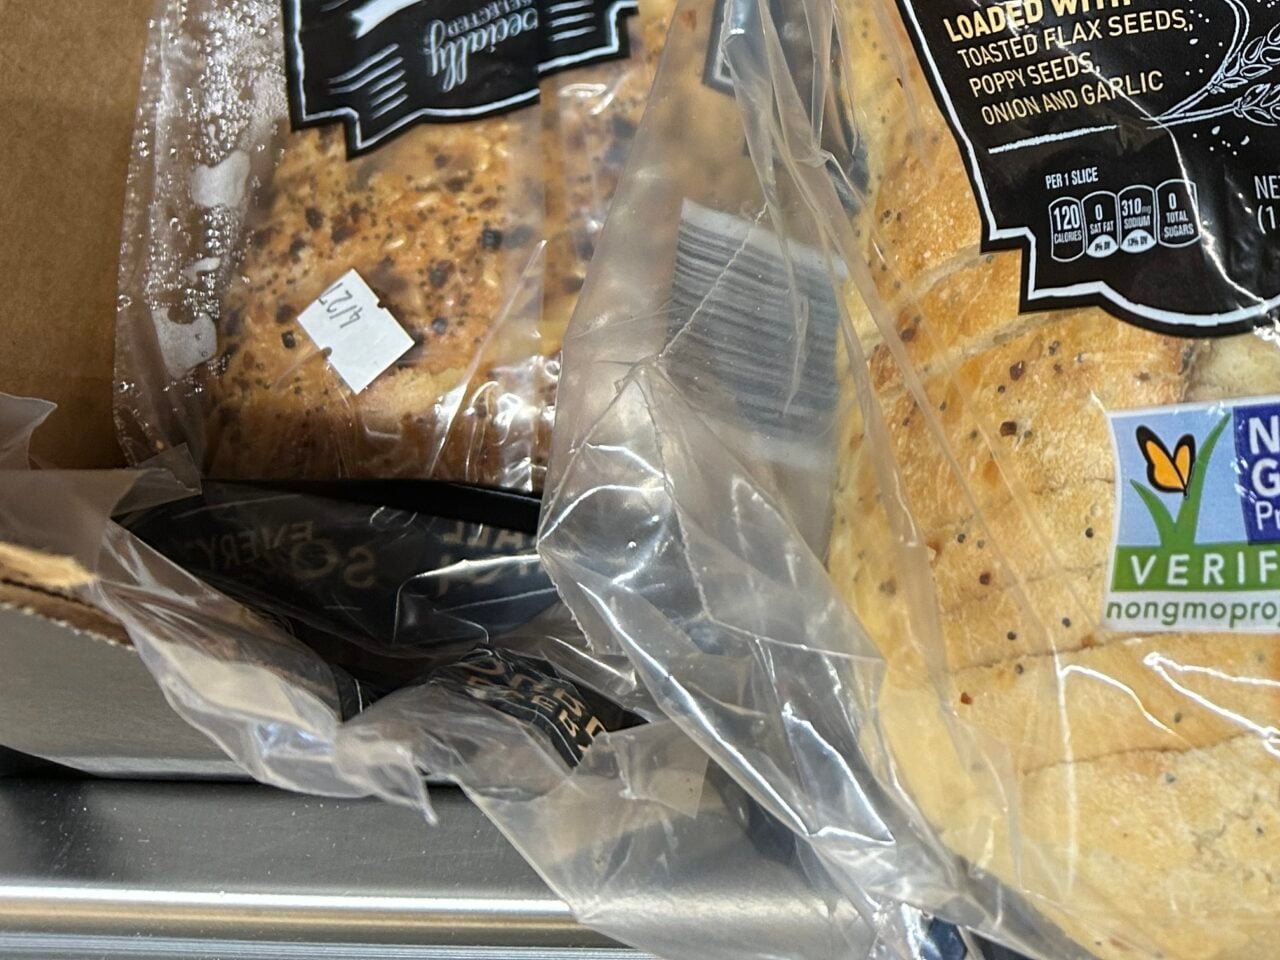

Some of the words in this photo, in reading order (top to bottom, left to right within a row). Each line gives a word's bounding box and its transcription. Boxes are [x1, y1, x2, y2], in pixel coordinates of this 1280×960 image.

[957, 34, 1039, 69] TOASTED
[1044, 19, 1102, 51] FLAX
[968, 68, 1027, 98] POPPY
[1027, 52, 1101, 86] SEEDS,
[981, 94, 1040, 126] ONION
[1042, 85, 1078, 113] AND
[1081, 69, 1165, 104] GARLIC
[1045, 174, 1063, 189] PER
[1064, 174, 1068, 186] 1
[1072, 166, 1099, 185] SLICE
[1168, 193, 1176, 209] 0
[1053, 204, 1080, 231] 120
[1095, 204, 1103, 221] 0
[1166, 210, 1188, 222] TOTAL
[1090, 222, 1101, 234] SAT
[1103, 221, 1114, 232] FAT
[1124, 215, 1150, 229] SODIUM
[1054, 230, 1082, 244] CALORIES
[1164, 224, 1194, 238] SUGARS
[318, 282, 364, 329] 4/27
